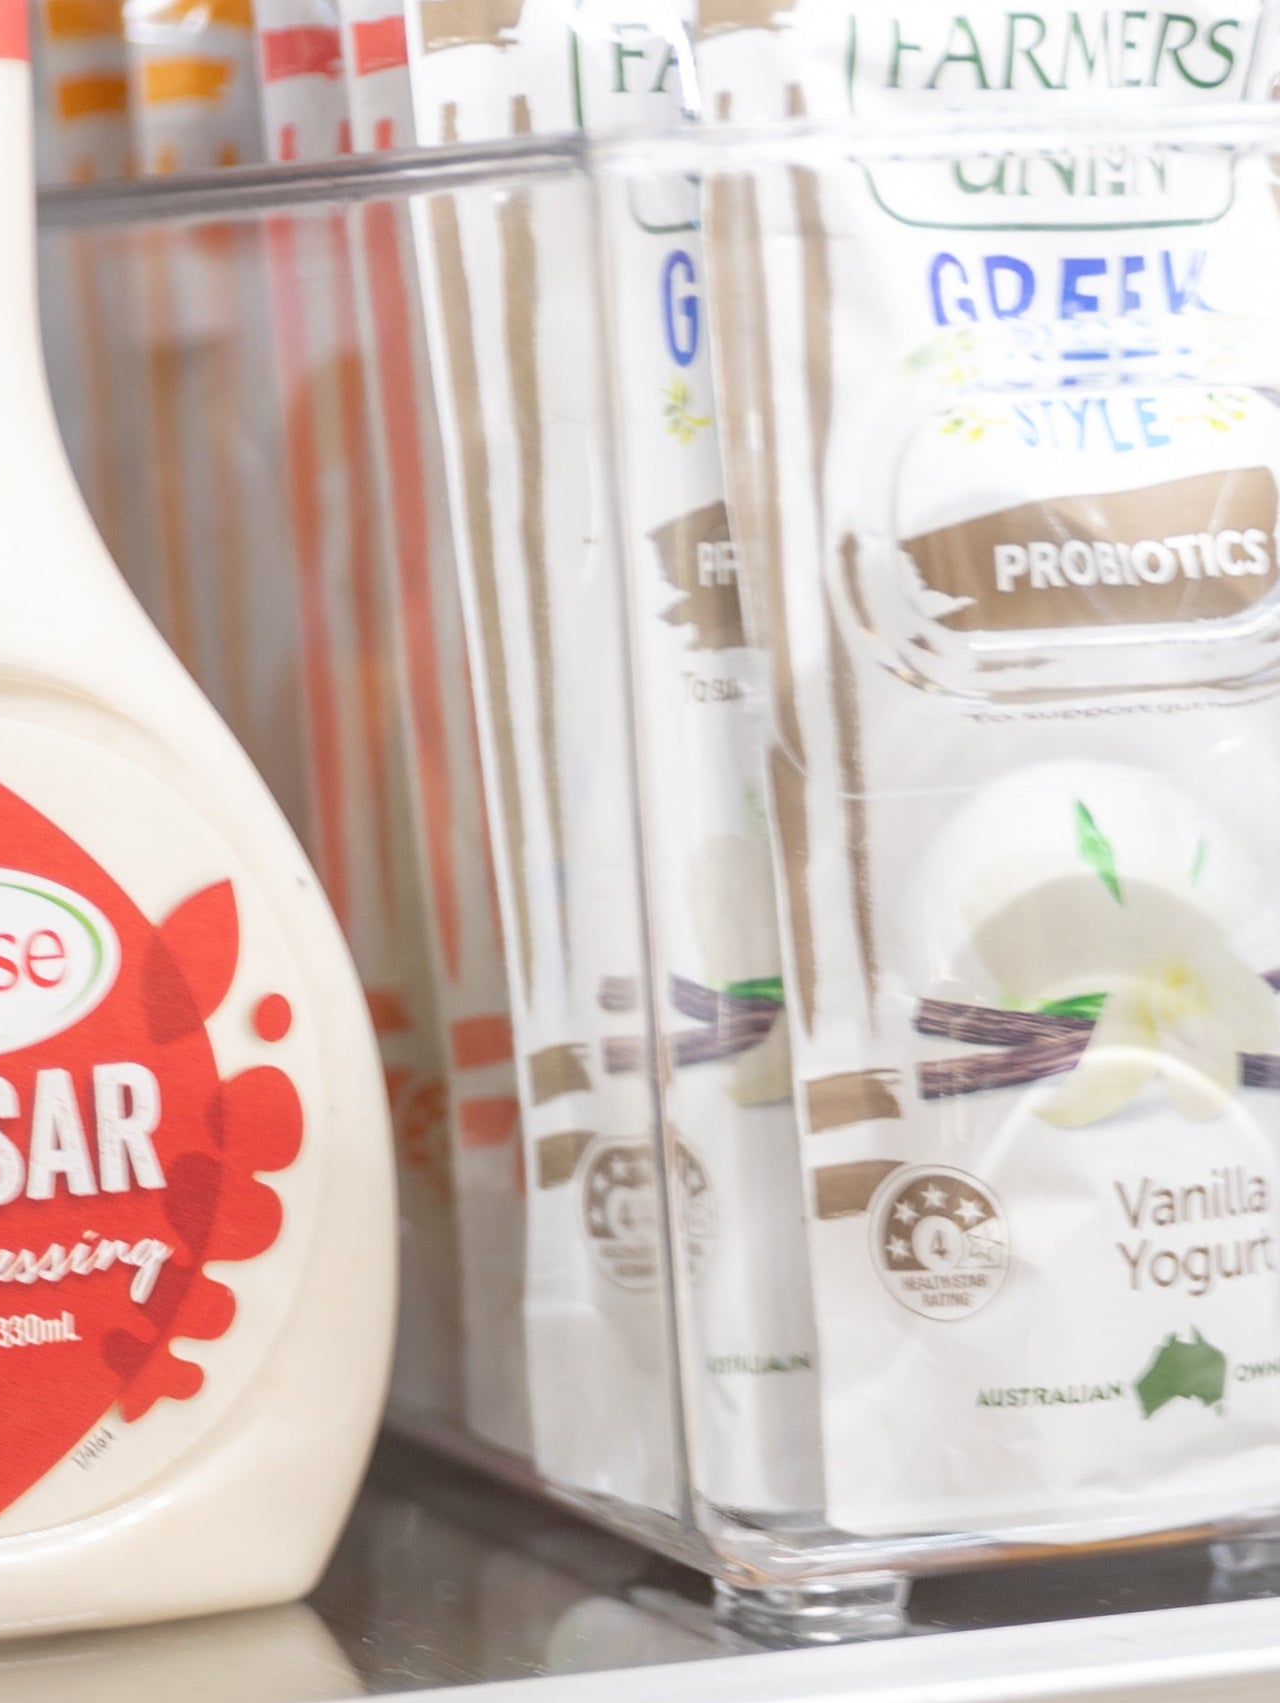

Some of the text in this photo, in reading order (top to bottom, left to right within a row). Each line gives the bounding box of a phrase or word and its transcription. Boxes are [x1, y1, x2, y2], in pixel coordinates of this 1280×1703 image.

[994, 526, 1272, 593] PROBIOTICS
[1114, 1166, 1268, 1230] Vanilla
[1116, 1234, 1276, 1296] Yogurt
[974, 1380, 1123, 1408] AUSTRALIAN
